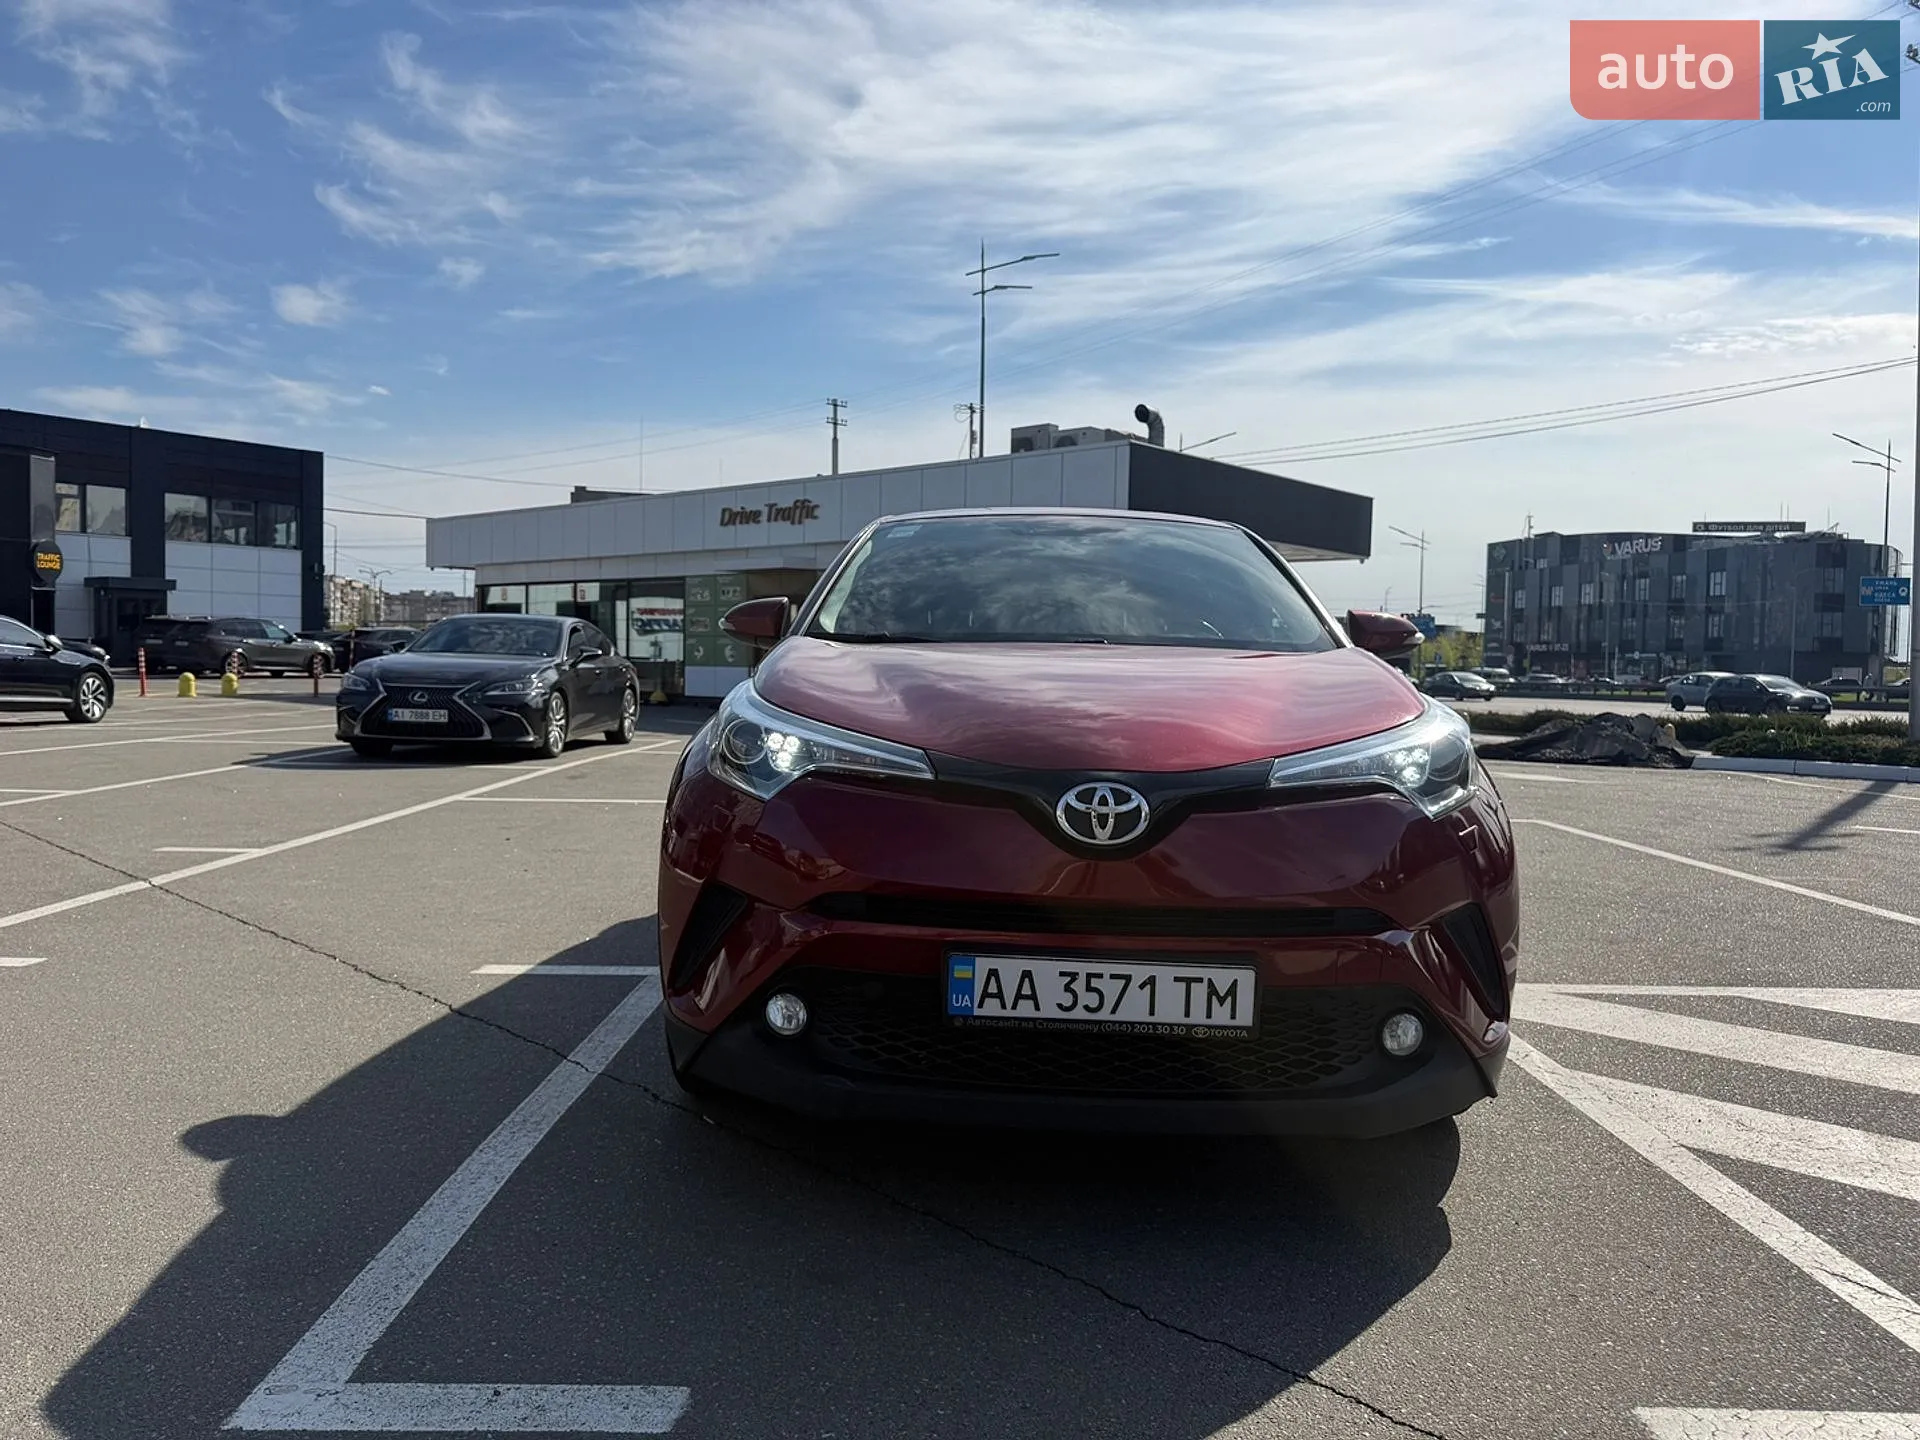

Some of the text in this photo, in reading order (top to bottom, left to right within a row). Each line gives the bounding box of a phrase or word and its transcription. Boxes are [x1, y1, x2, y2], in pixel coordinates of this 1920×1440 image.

[719, 498, 820, 527] Drive Traffic
[1613, 536, 1663, 555] VARUS
[37, 552, 61, 561] TRAFFIC
[37, 560, 61, 570] LOUNGE
[951, 993, 972, 1008] UA
[976, 967, 1239, 1021] AA 3571 TM
[1100, 1022, 1132, 1034] (044)
[1133, 1024, 1154, 1034] 201
[1155, 1025, 1171, 1035] 30
[1171, 1026, 1187, 1036] 30
[1208, 1029, 1249, 1039] TOYOTA
